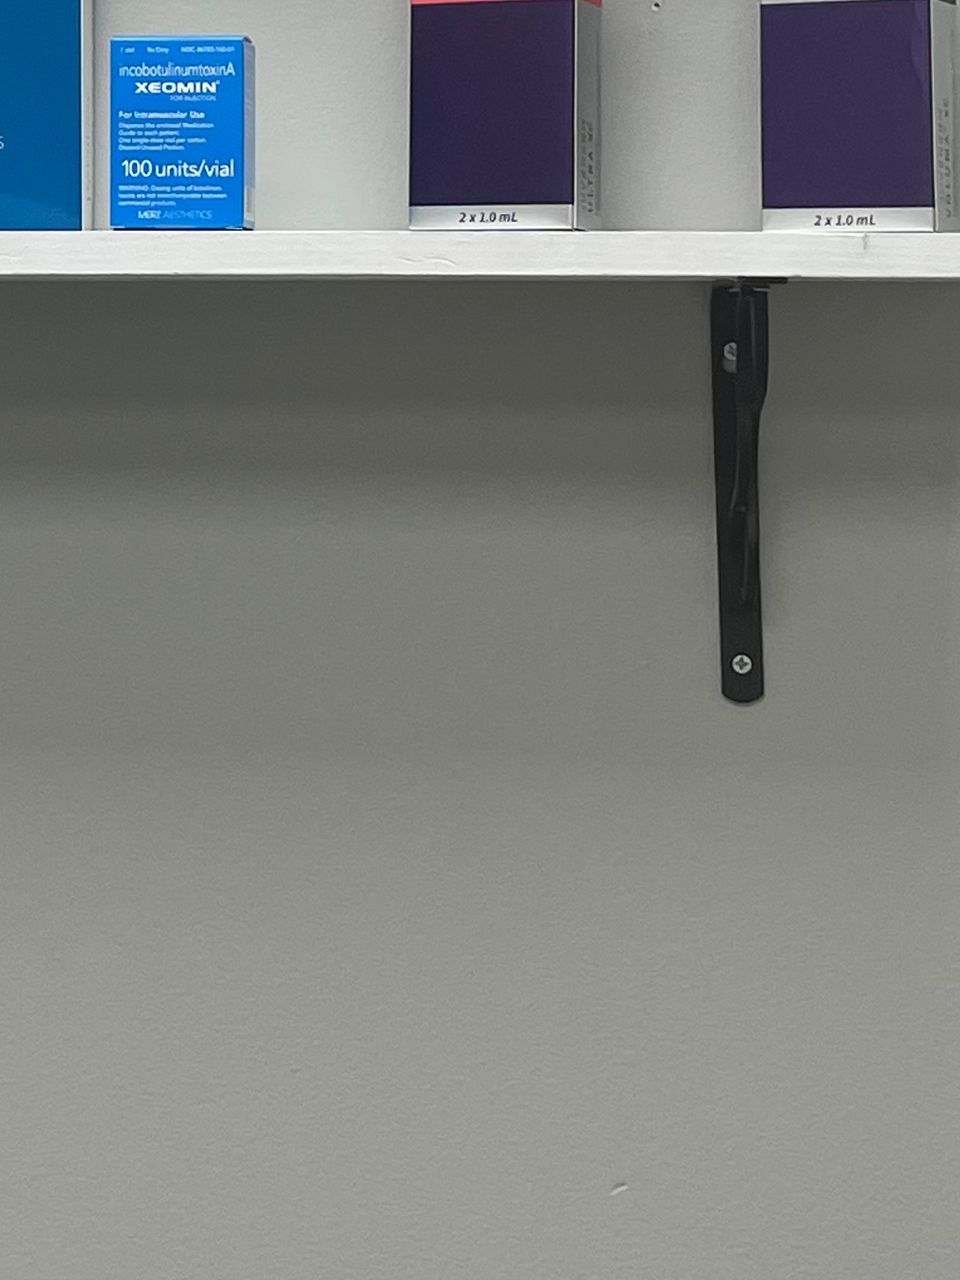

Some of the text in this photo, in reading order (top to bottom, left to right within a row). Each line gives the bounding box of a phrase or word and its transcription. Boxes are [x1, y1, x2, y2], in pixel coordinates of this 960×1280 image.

[119, 62, 236, 77] incobotulinumtoxinA
[118, 110, 206, 119] For Intramuscular Use
[121, 158, 235, 178] 100 units/vial
[138, 210, 161, 219] MERZ
[458, 212, 518, 223] 2 x 1.0 mL
[813, 214, 876, 226] 2 x 1.0 mL
